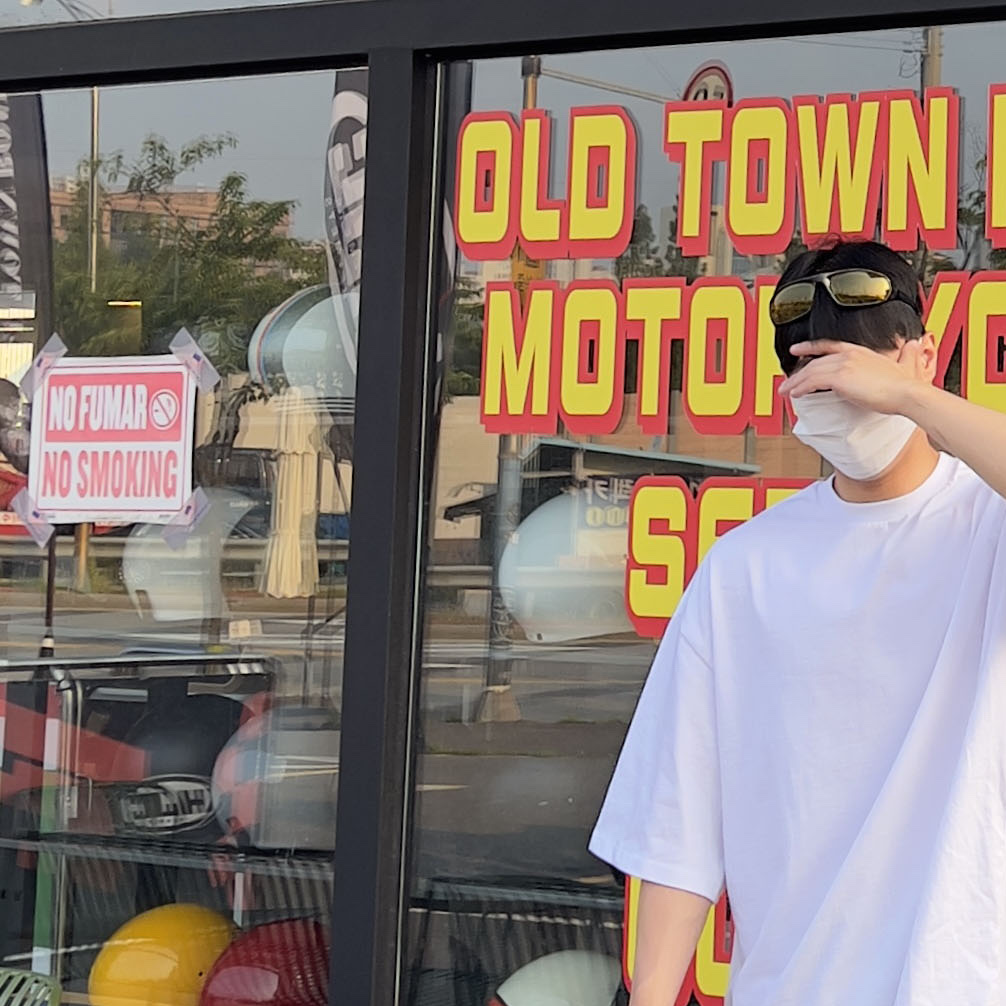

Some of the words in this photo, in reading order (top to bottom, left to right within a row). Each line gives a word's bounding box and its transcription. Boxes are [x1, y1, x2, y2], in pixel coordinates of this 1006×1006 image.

[456, 106, 637, 260] OLD
[663, 87, 960, 256] TOWN
[48, 385, 77, 432] NO
[78, 383, 148, 431] FUMAR
[41, 450, 72, 499] NO
[76, 449, 178, 499] SMOKING
